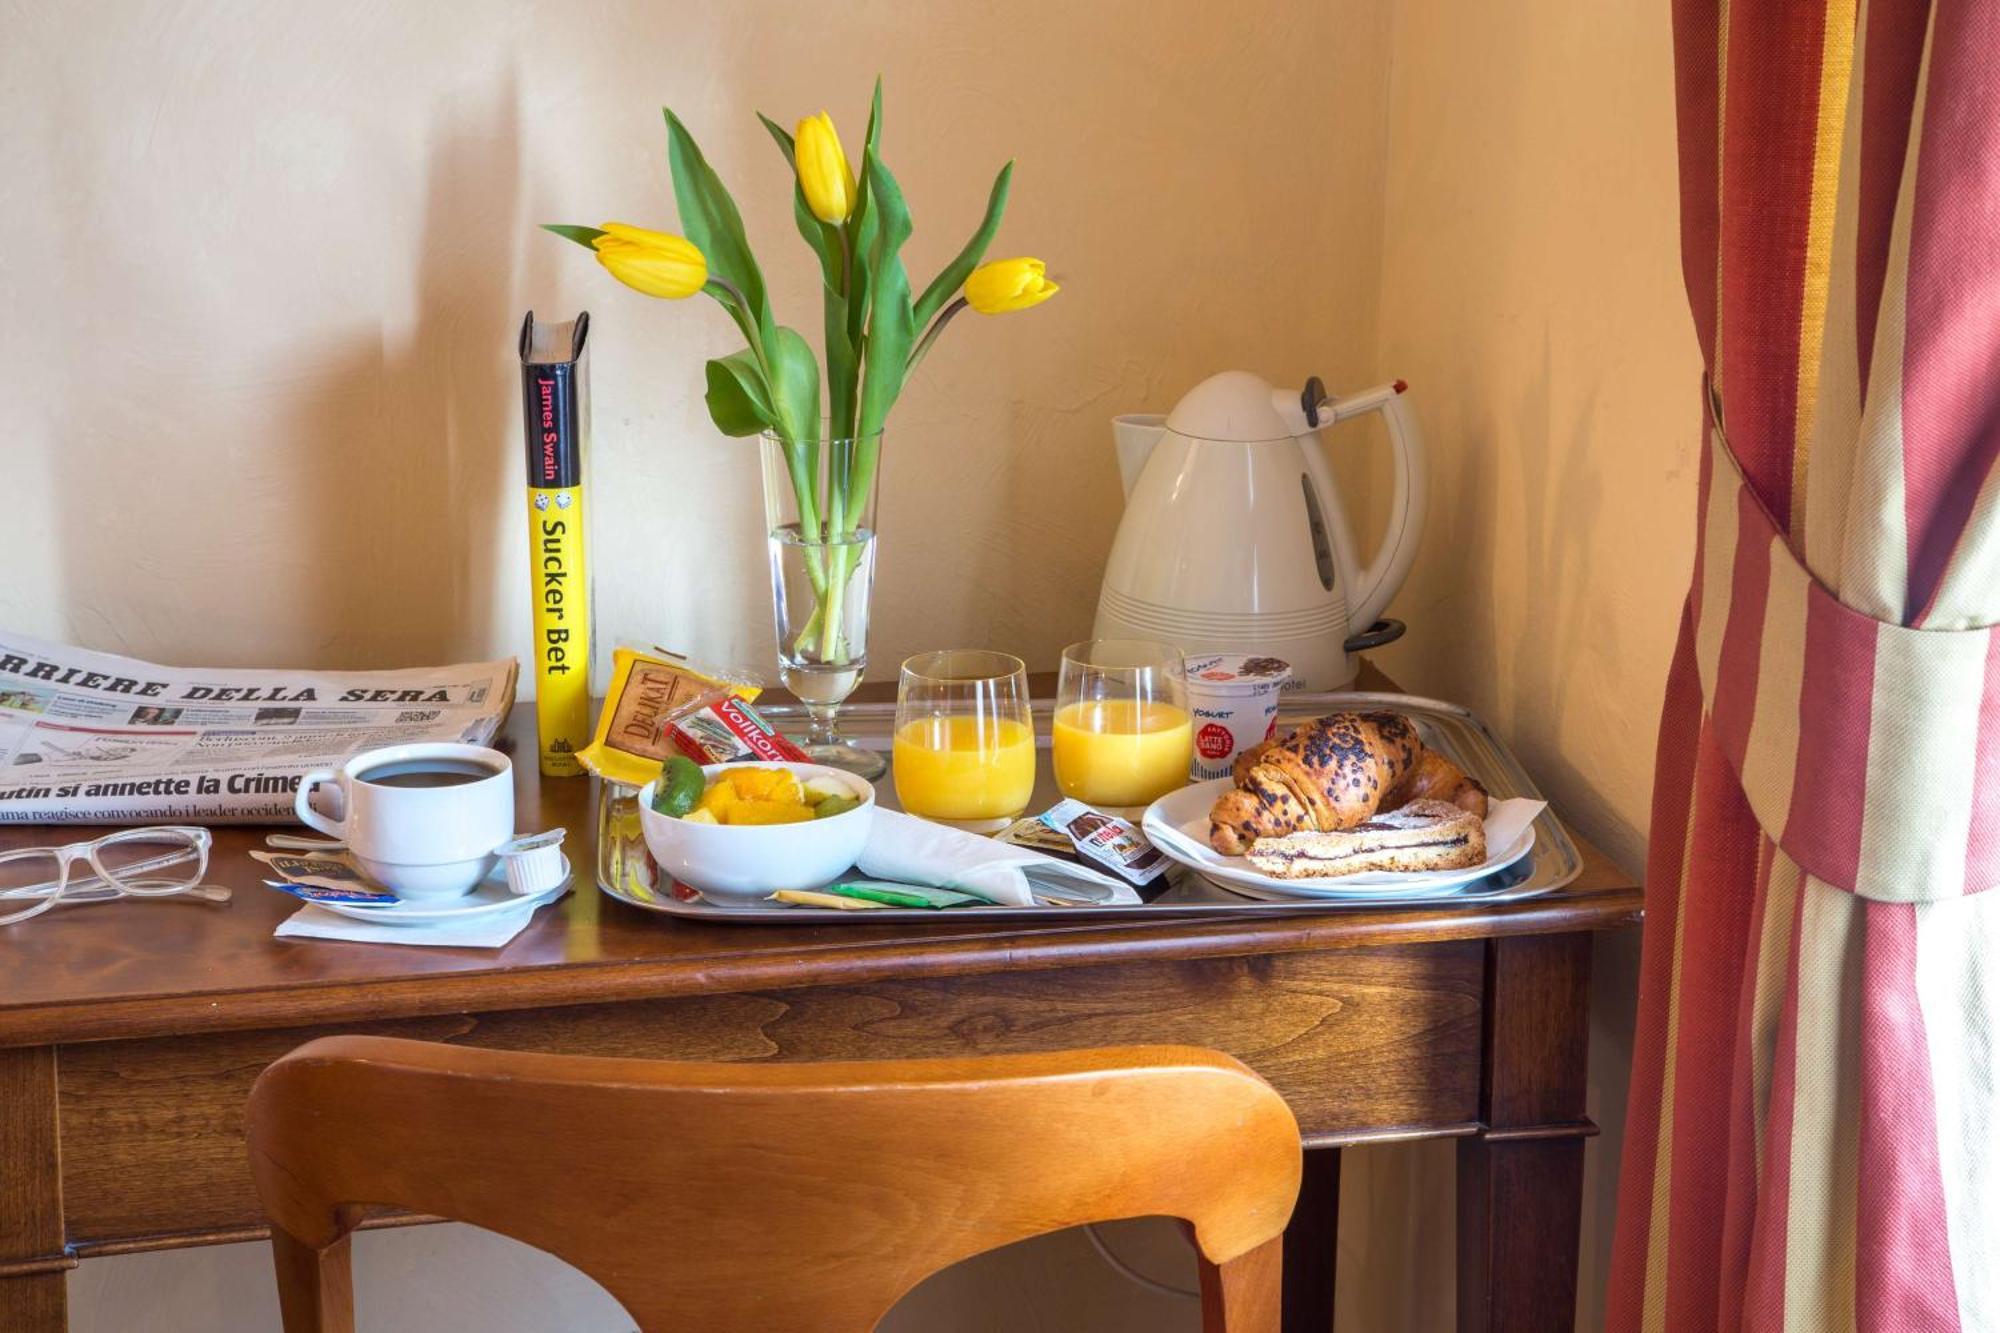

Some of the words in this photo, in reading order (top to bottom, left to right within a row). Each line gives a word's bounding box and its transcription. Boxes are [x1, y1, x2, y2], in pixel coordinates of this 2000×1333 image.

[538, 379, 556, 427] James
[543, 433, 559, 480] Swain
[542, 520, 568, 620] Sucker
[547, 628, 572, 675] Bet
[0, 654, 170, 697] RRIERE
[181, 685, 318, 702] DELLA
[338, 688, 450, 702] SERA
[1281, 678, 1306, 692] otel
[1192, 707, 1234, 719] YOGURT
[56, 784, 81, 798] si
[85, 777, 190, 797] annette
[198, 775, 220, 795] la
[31, 807, 92, 822] reagisce
[93, 803, 183, 819] convocando
[185, 804, 191, 817] i
[192, 803, 236, 817] leader
